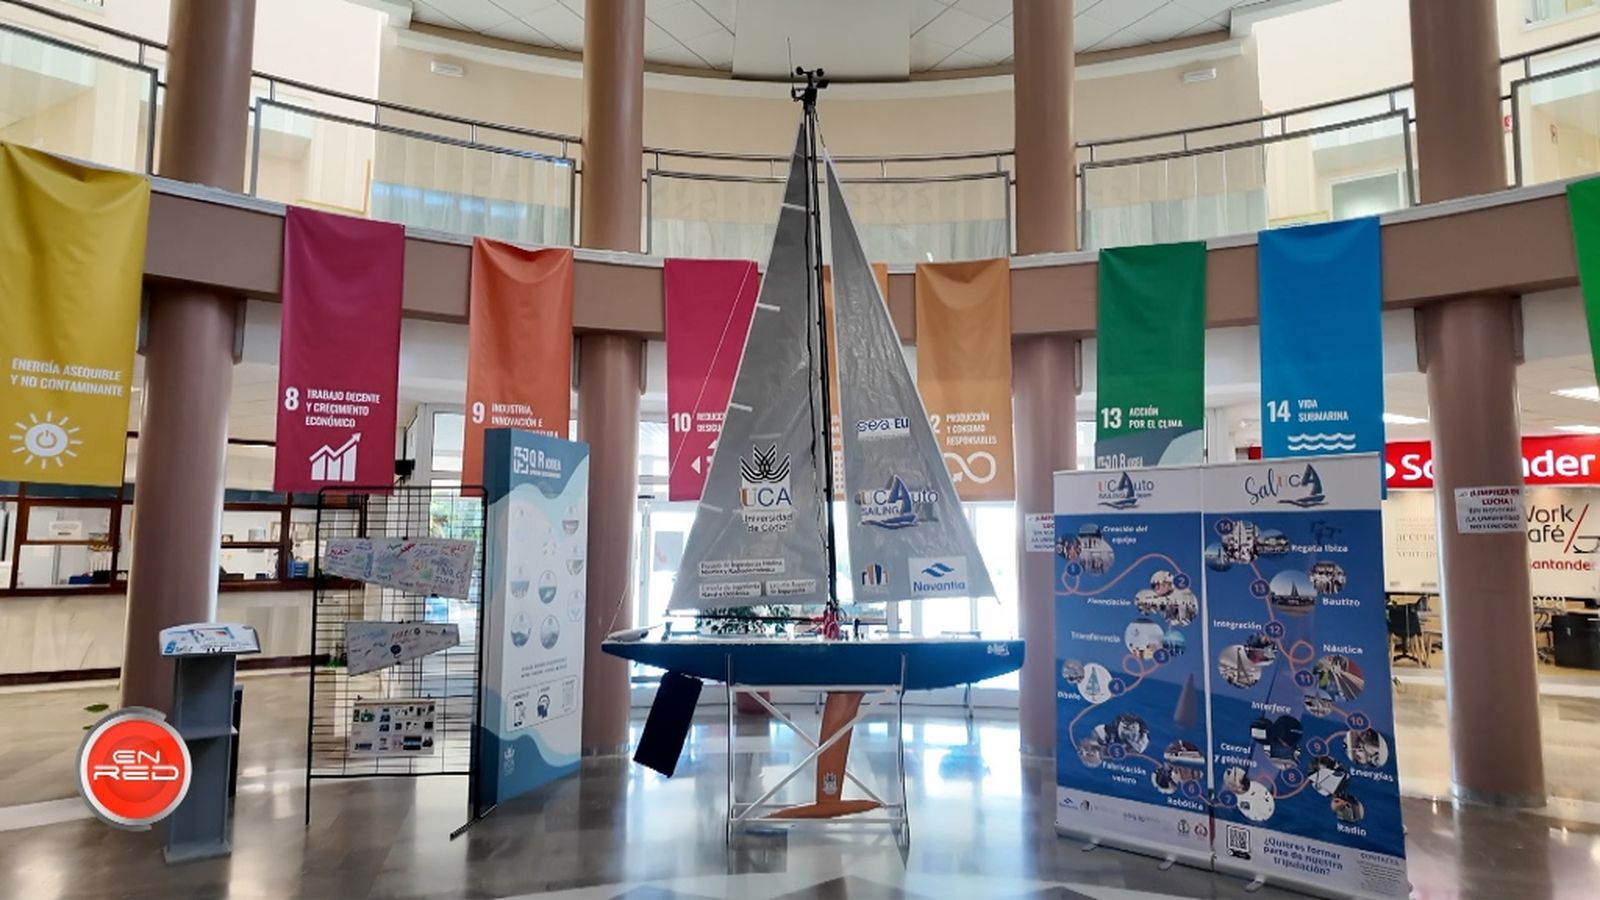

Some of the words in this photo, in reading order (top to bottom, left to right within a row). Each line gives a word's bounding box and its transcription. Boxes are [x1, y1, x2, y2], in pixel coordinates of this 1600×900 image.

[12, 358, 60, 374] ENERGÍA
[63, 365, 122, 381] ASEQUIBLE
[10, 374, 18, 386] Y
[20, 376, 37, 388] NO
[40, 378, 124, 397] CONTAMINANTE
[284, 387, 299, 411] 8
[306, 388, 344, 401] TRABAJO
[345, 392, 380, 404] DECENTE
[306, 402, 313, 412] Y
[313, 402, 369, 416] CRECIMIENTO
[491, 403, 533, 416] INDUSTRIA,
[1128, 404, 1159, 417] ACCIÓN
[1298, 399, 1318, 409] VIDA
[472, 401, 485, 424] 9
[946, 412, 990, 423] PRODUCCIÓN
[1266, 400, 1291, 422] 14
[1298, 411, 1349, 422] SUBMARINA
[305, 415, 356, 427] ECONÓMICO
[491, 415, 537, 427] INNOVACIÓN
[538, 418, 544, 428] E
[671, 412, 692, 432] 10
[930, 415, 942, 433] 2
[1100, 407, 1122, 429] 13
[1128, 419, 1146, 429] POR
[1147, 419, 1156, 429] EL
[1157, 419, 1183, 429] CLIMA
[952, 424, 986, 433] CONSUMO
[946, 436, 997, 445] RESPONSABLES
[742, 487, 792, 507] UCA
[1220, 523, 1231, 531] 14
[1527, 524, 1565, 543] afé
[913, 580, 966, 592] Navantia
[1178, 579, 1185, 587] 2
[1254, 584, 1265, 593] 13
[1213, 620, 1262, 631] Integración
[1270, 626, 1280, 634] 12
[1323, 644, 1363, 654] Náutica
[1300, 674, 1311, 682] 11
[1351, 717, 1363, 726] 10
[1350, 769, 1393, 783] Energías
[1337, 823, 1367, 837] Radio
[1264, 836, 1305, 851] ¿Quieres
[1307, 845, 1341, 860] formar
[1273, 856, 1331, 876] tripulación?
[1291, 851, 1302, 861] de
[1305, 855, 1343, 870] nuestra
